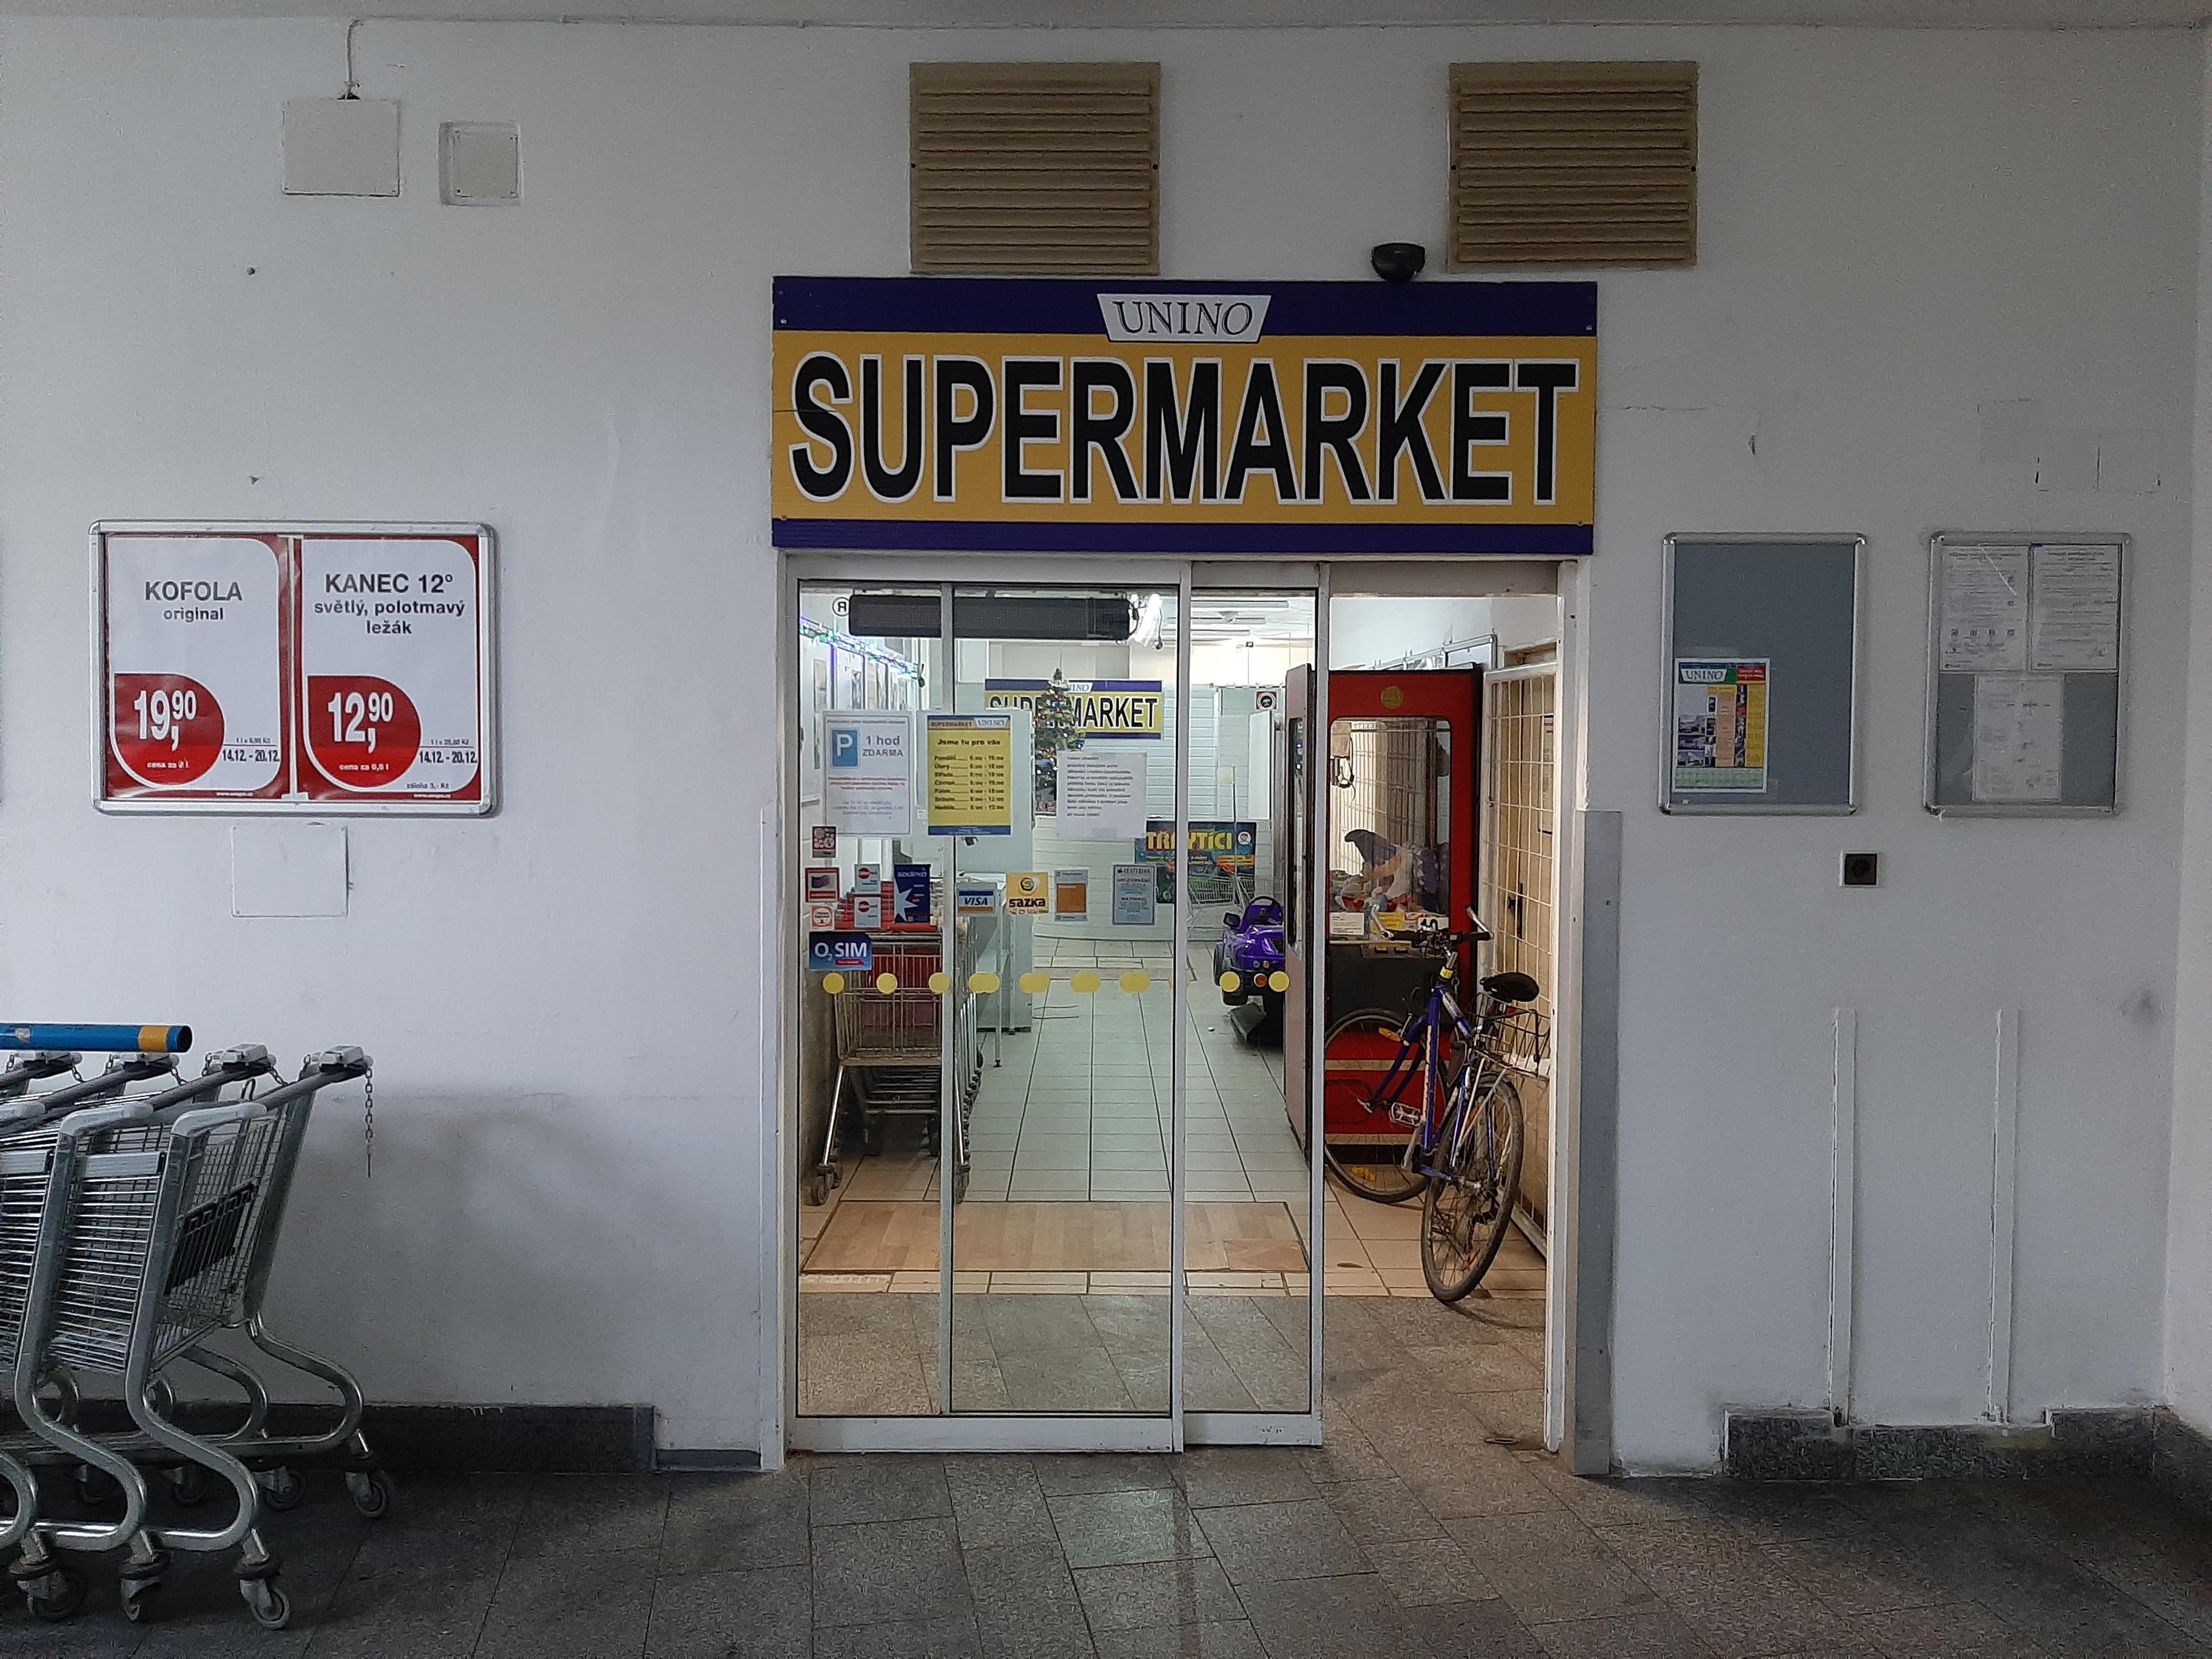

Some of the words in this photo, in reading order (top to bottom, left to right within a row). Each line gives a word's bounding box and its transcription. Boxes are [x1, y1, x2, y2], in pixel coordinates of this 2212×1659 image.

[1110, 299, 1255, 338] UNINO
[792, 354, 1578, 501] SUPERMARKET
[145, 581, 243, 601] KOFOLA
[325, 573, 409, 593] KANEC
[163, 607, 223, 623] original
[314, 599, 368, 617] světlý,
[374, 600, 465, 617] polotmavý
[366, 619, 413, 634] ležák
[1686, 670, 1723, 681] UNINO
[990, 696, 1158, 728] MARKET
[836, 733, 853, 757] P
[877, 735, 900, 745] hod
[862, 749, 904, 757] ZDARMA
[964, 897, 988, 906] VISA
[1009, 898, 1046, 907] sazka
[834, 942, 867, 958] SIM
